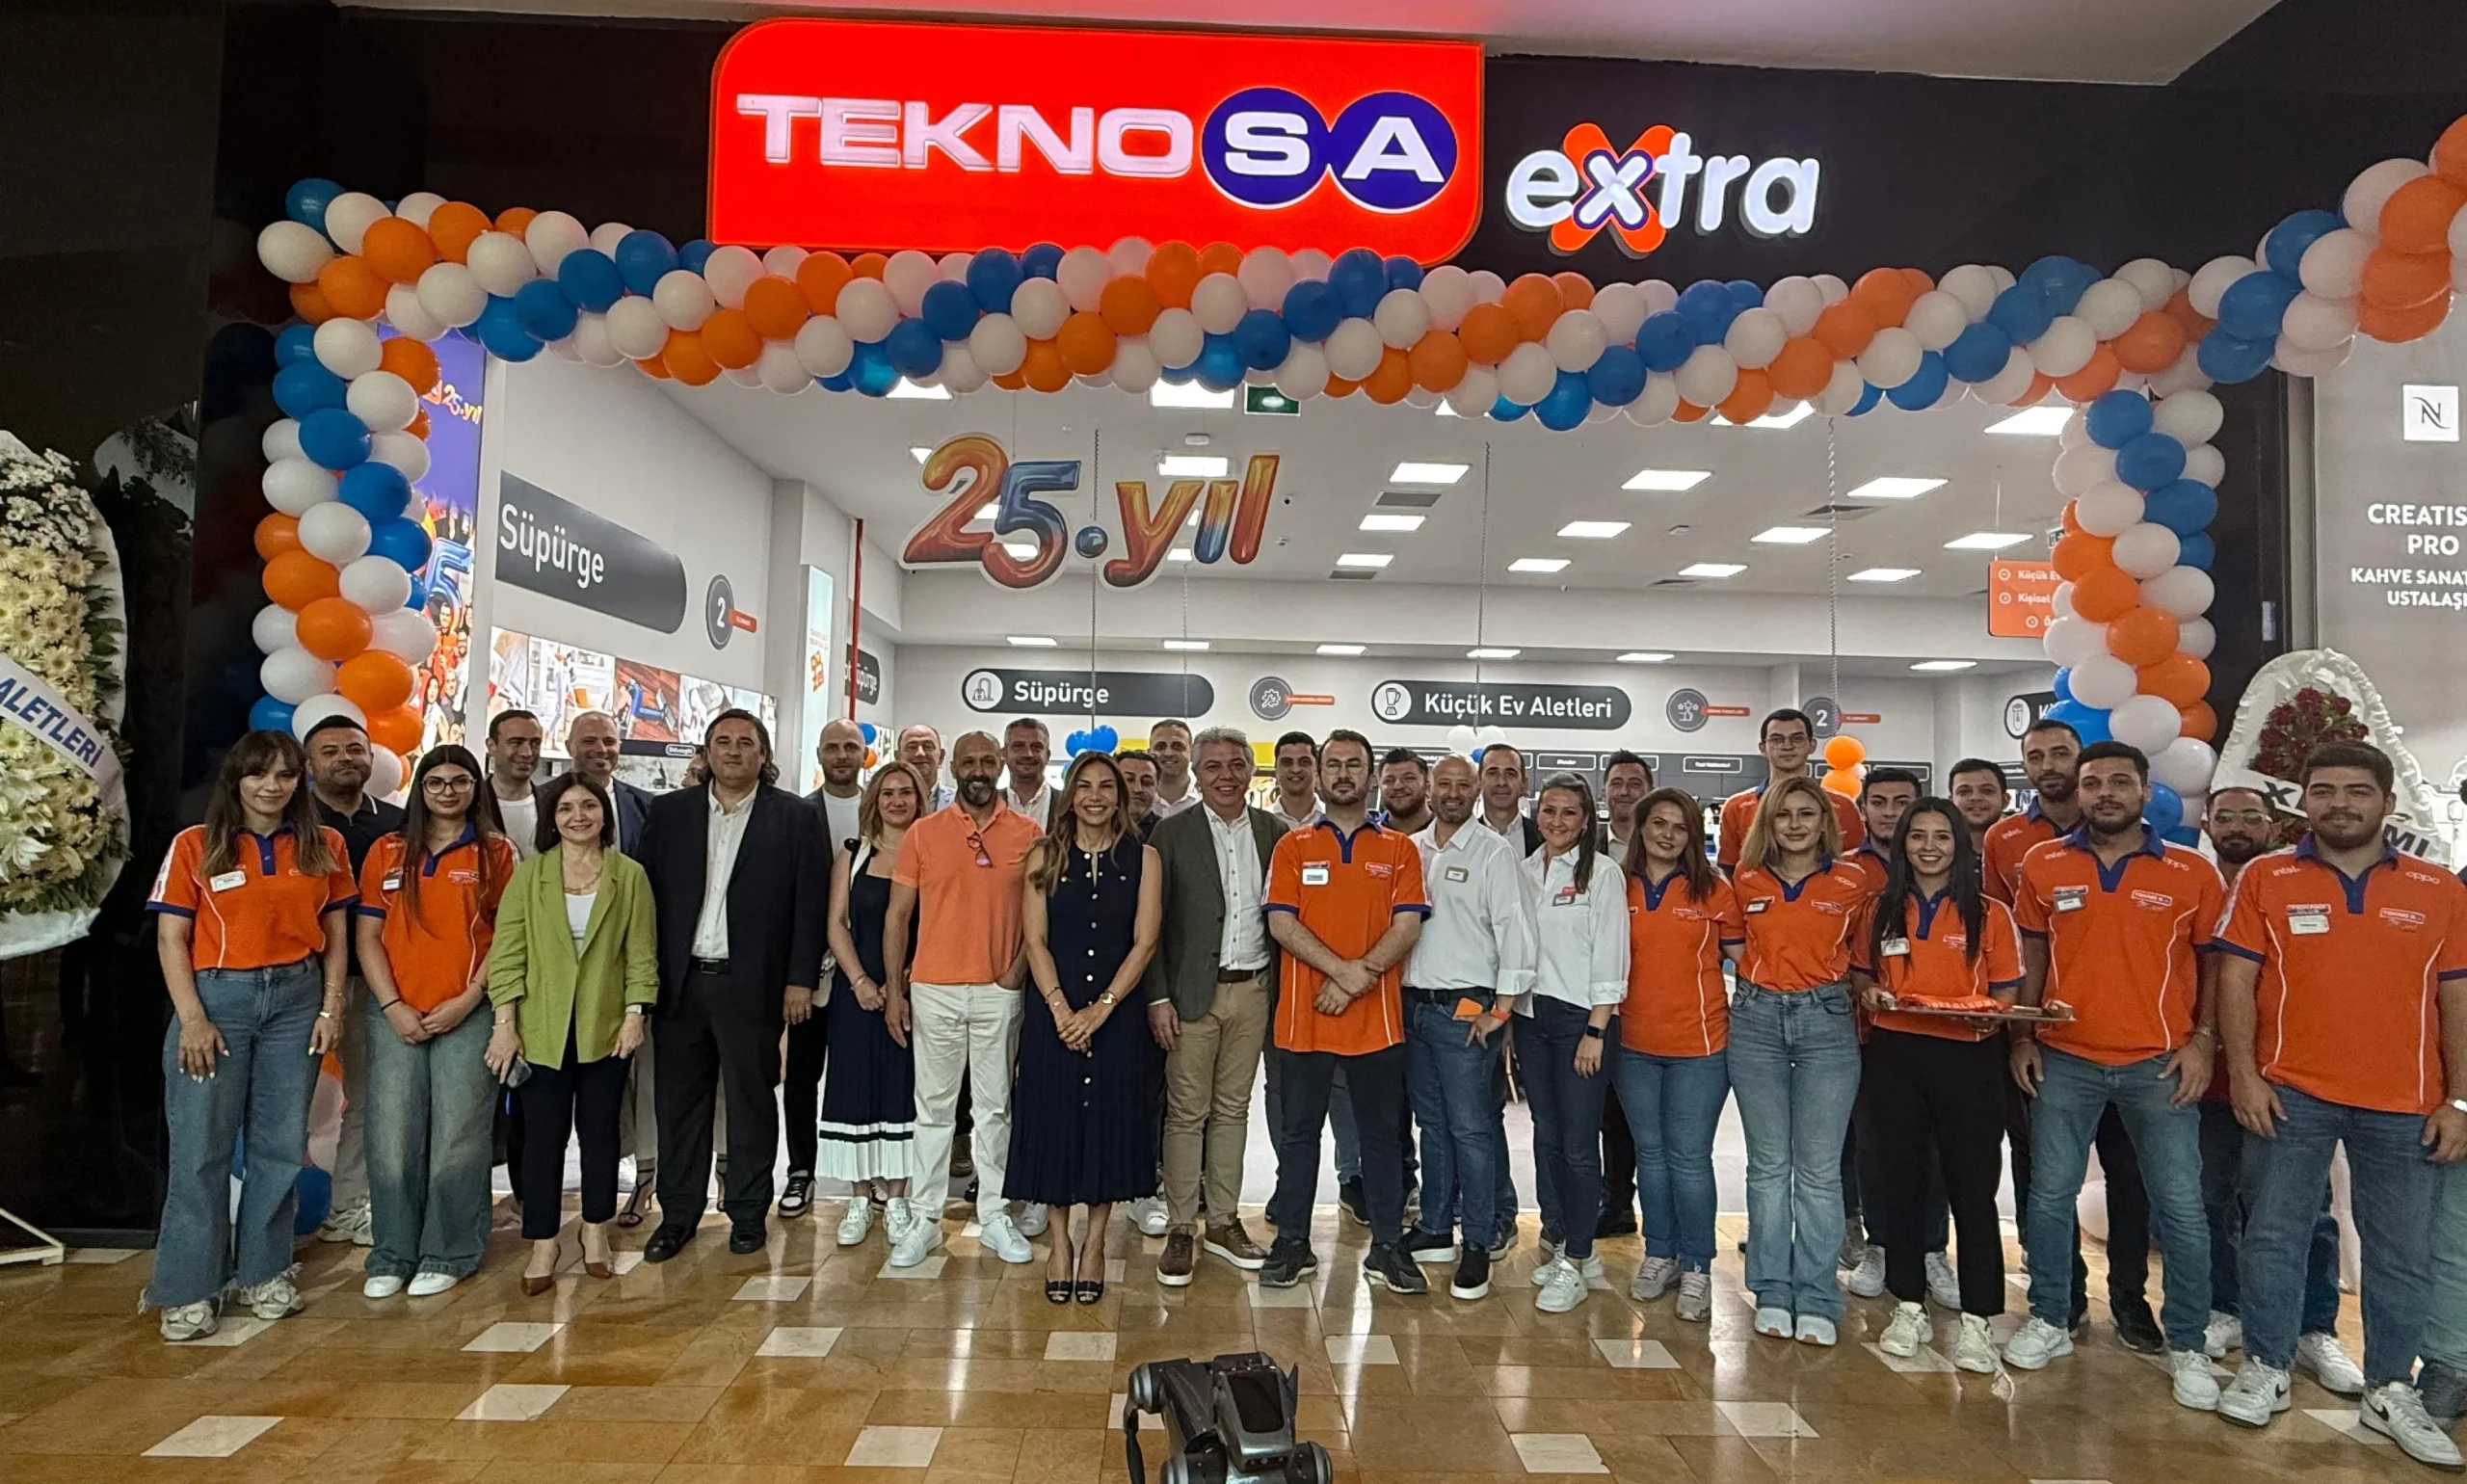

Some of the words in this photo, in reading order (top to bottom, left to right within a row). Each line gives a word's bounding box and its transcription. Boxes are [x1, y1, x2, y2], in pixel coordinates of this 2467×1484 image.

[736, 93, 1446, 183] TEKNOSA
[1506, 123, 1819, 252] extra
[500, 503, 604, 589] Süpürge
[2407, 534, 2459, 556] PRO
[2350, 567, 2413, 584] KAHVE
[716, 596, 727, 627] 2
[2387, 590, 2467, 610] USTALAŞ
[1014, 679, 1109, 708] Süpürge
[1425, 693, 1493, 720] Küçük
[1499, 695, 1525, 715] Ev
[1529, 696, 1612, 718] Aletleri
[1816, 709, 1828, 728] 2
